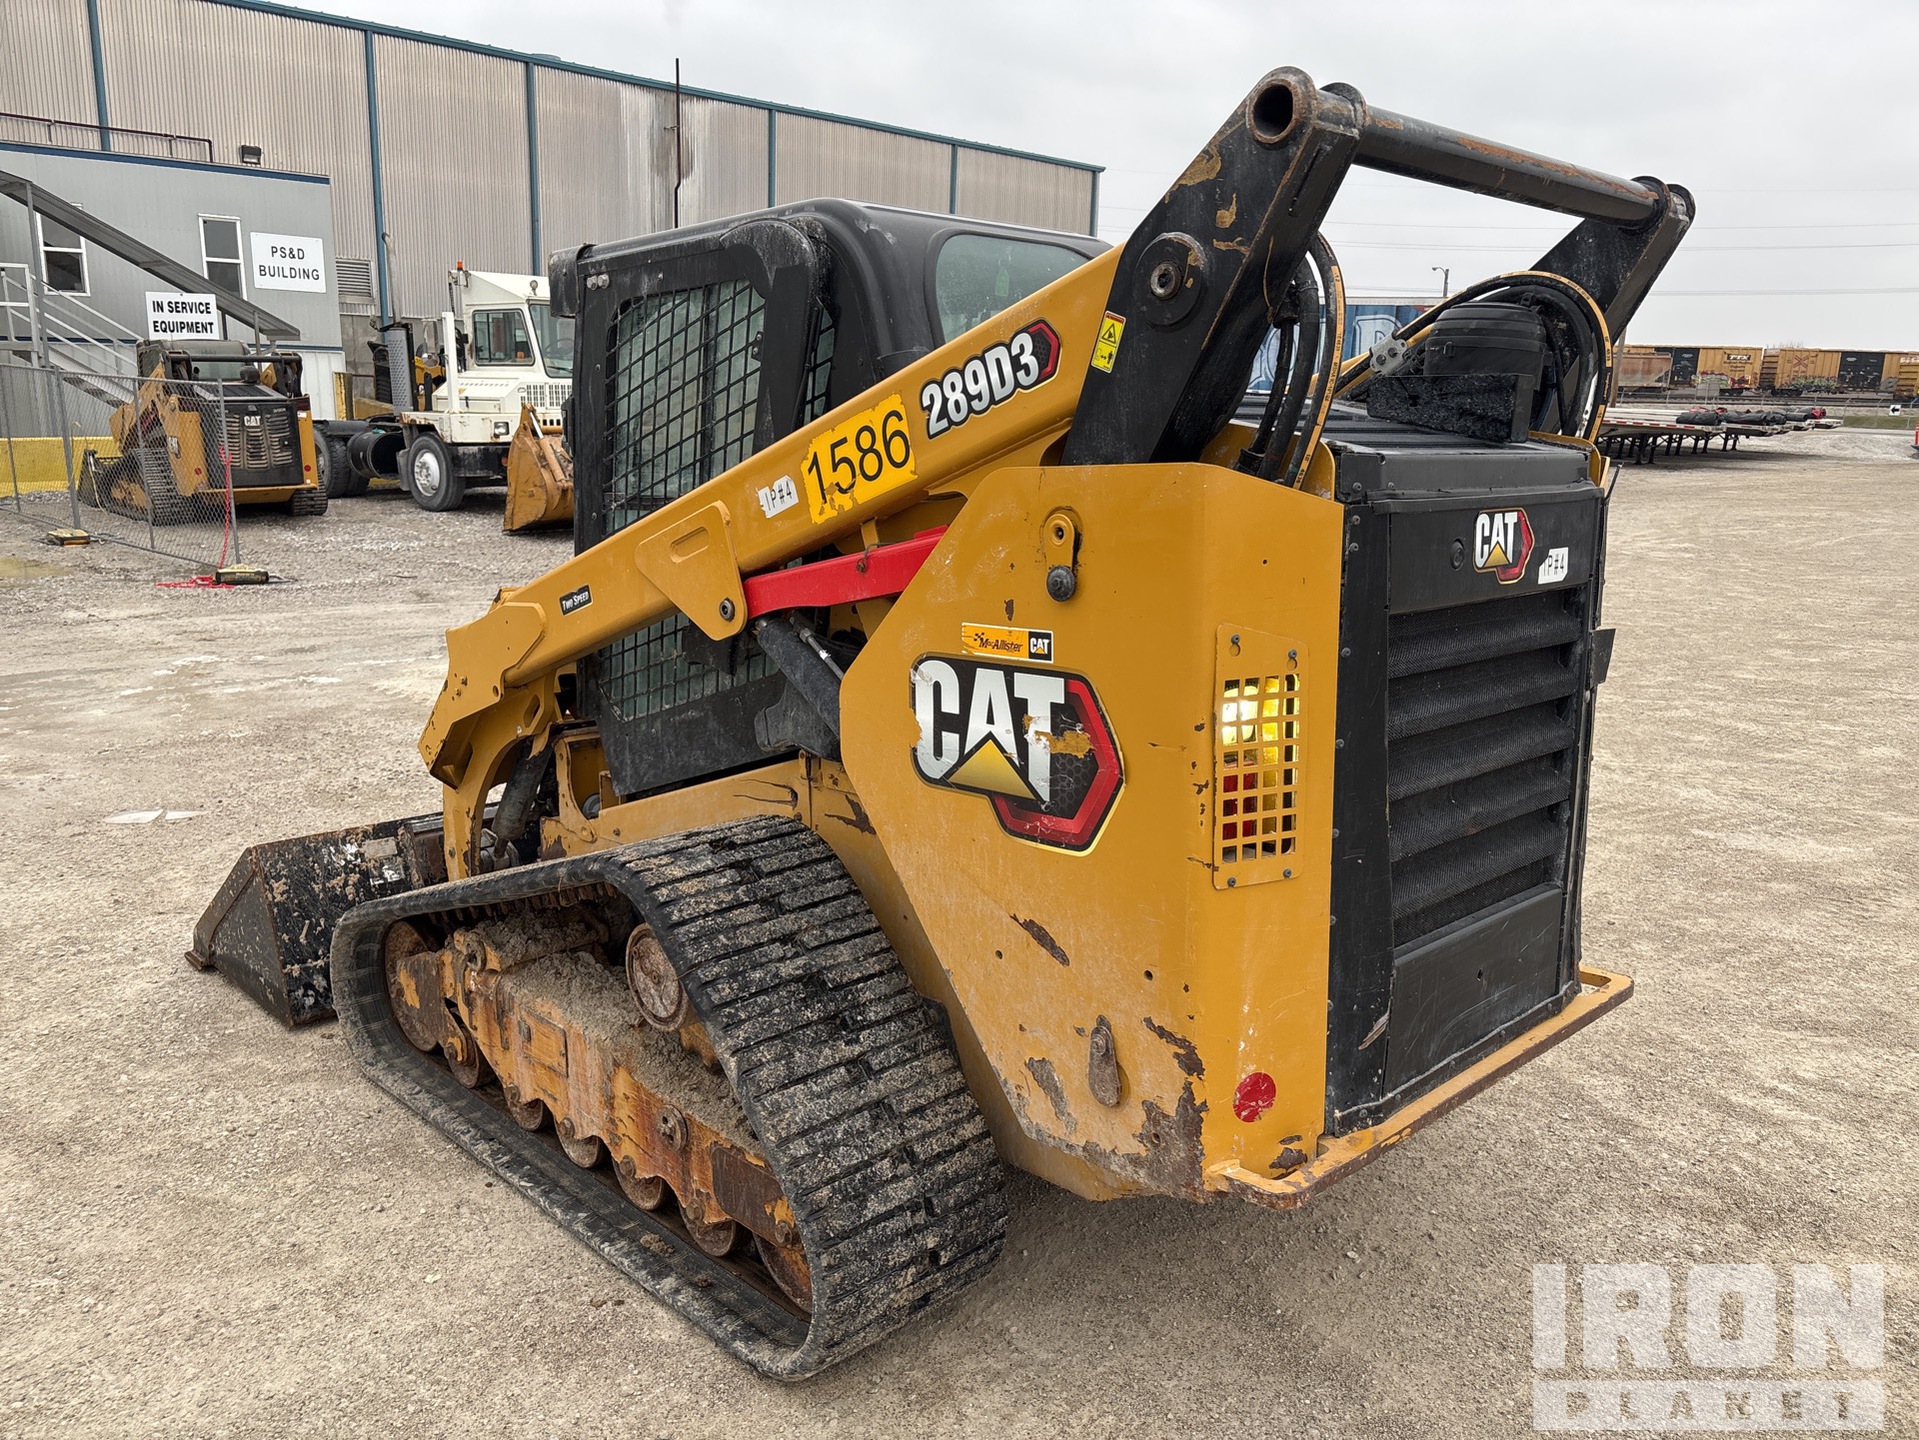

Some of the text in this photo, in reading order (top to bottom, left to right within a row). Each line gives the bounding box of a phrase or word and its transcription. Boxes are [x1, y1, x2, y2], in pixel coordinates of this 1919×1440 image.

[270, 245, 305, 260] PS&D
[258, 264, 320, 280] BUILDING
[152, 300, 211, 314] IN SERVICE
[152, 320, 214, 334] EQUIPMENT
[922, 332, 1040, 436] 289D3
[243, 415, 261, 427] CAT
[807, 409, 911, 505] 1586
[1475, 511, 1518, 568] CAT
[1029, 637, 1050, 655] CAT
[914, 659, 1066, 803] CAT
